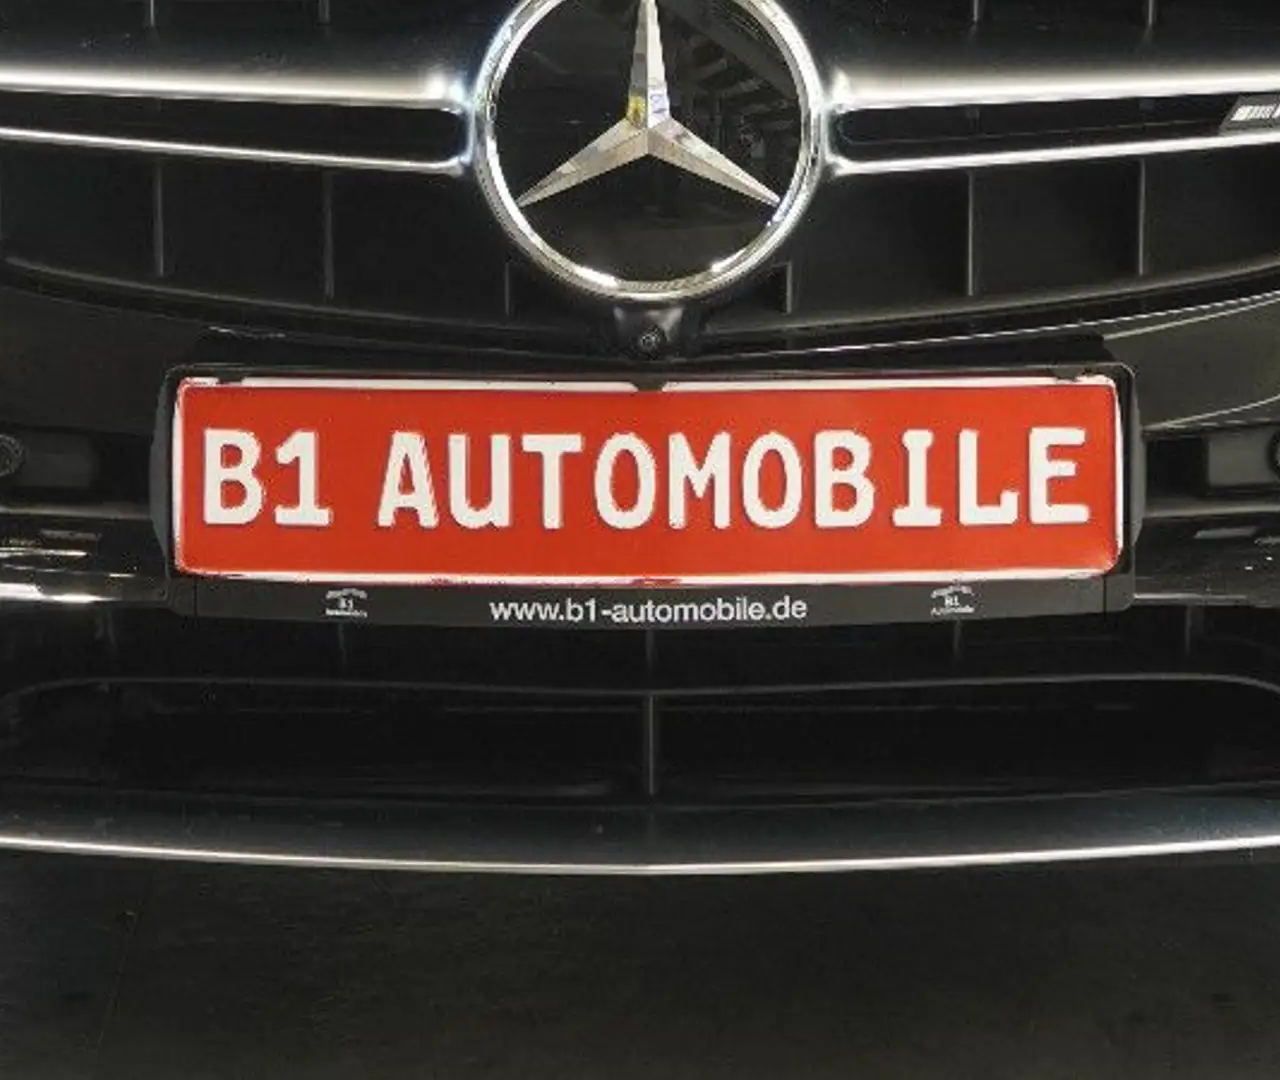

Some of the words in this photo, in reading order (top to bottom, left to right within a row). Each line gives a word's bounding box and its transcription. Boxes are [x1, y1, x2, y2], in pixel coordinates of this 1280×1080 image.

[202, 427, 333, 529] B1
[376, 425, 1091, 530] AUTOMOBILE
[489, 595, 808, 623] www.b1-automobile.de
